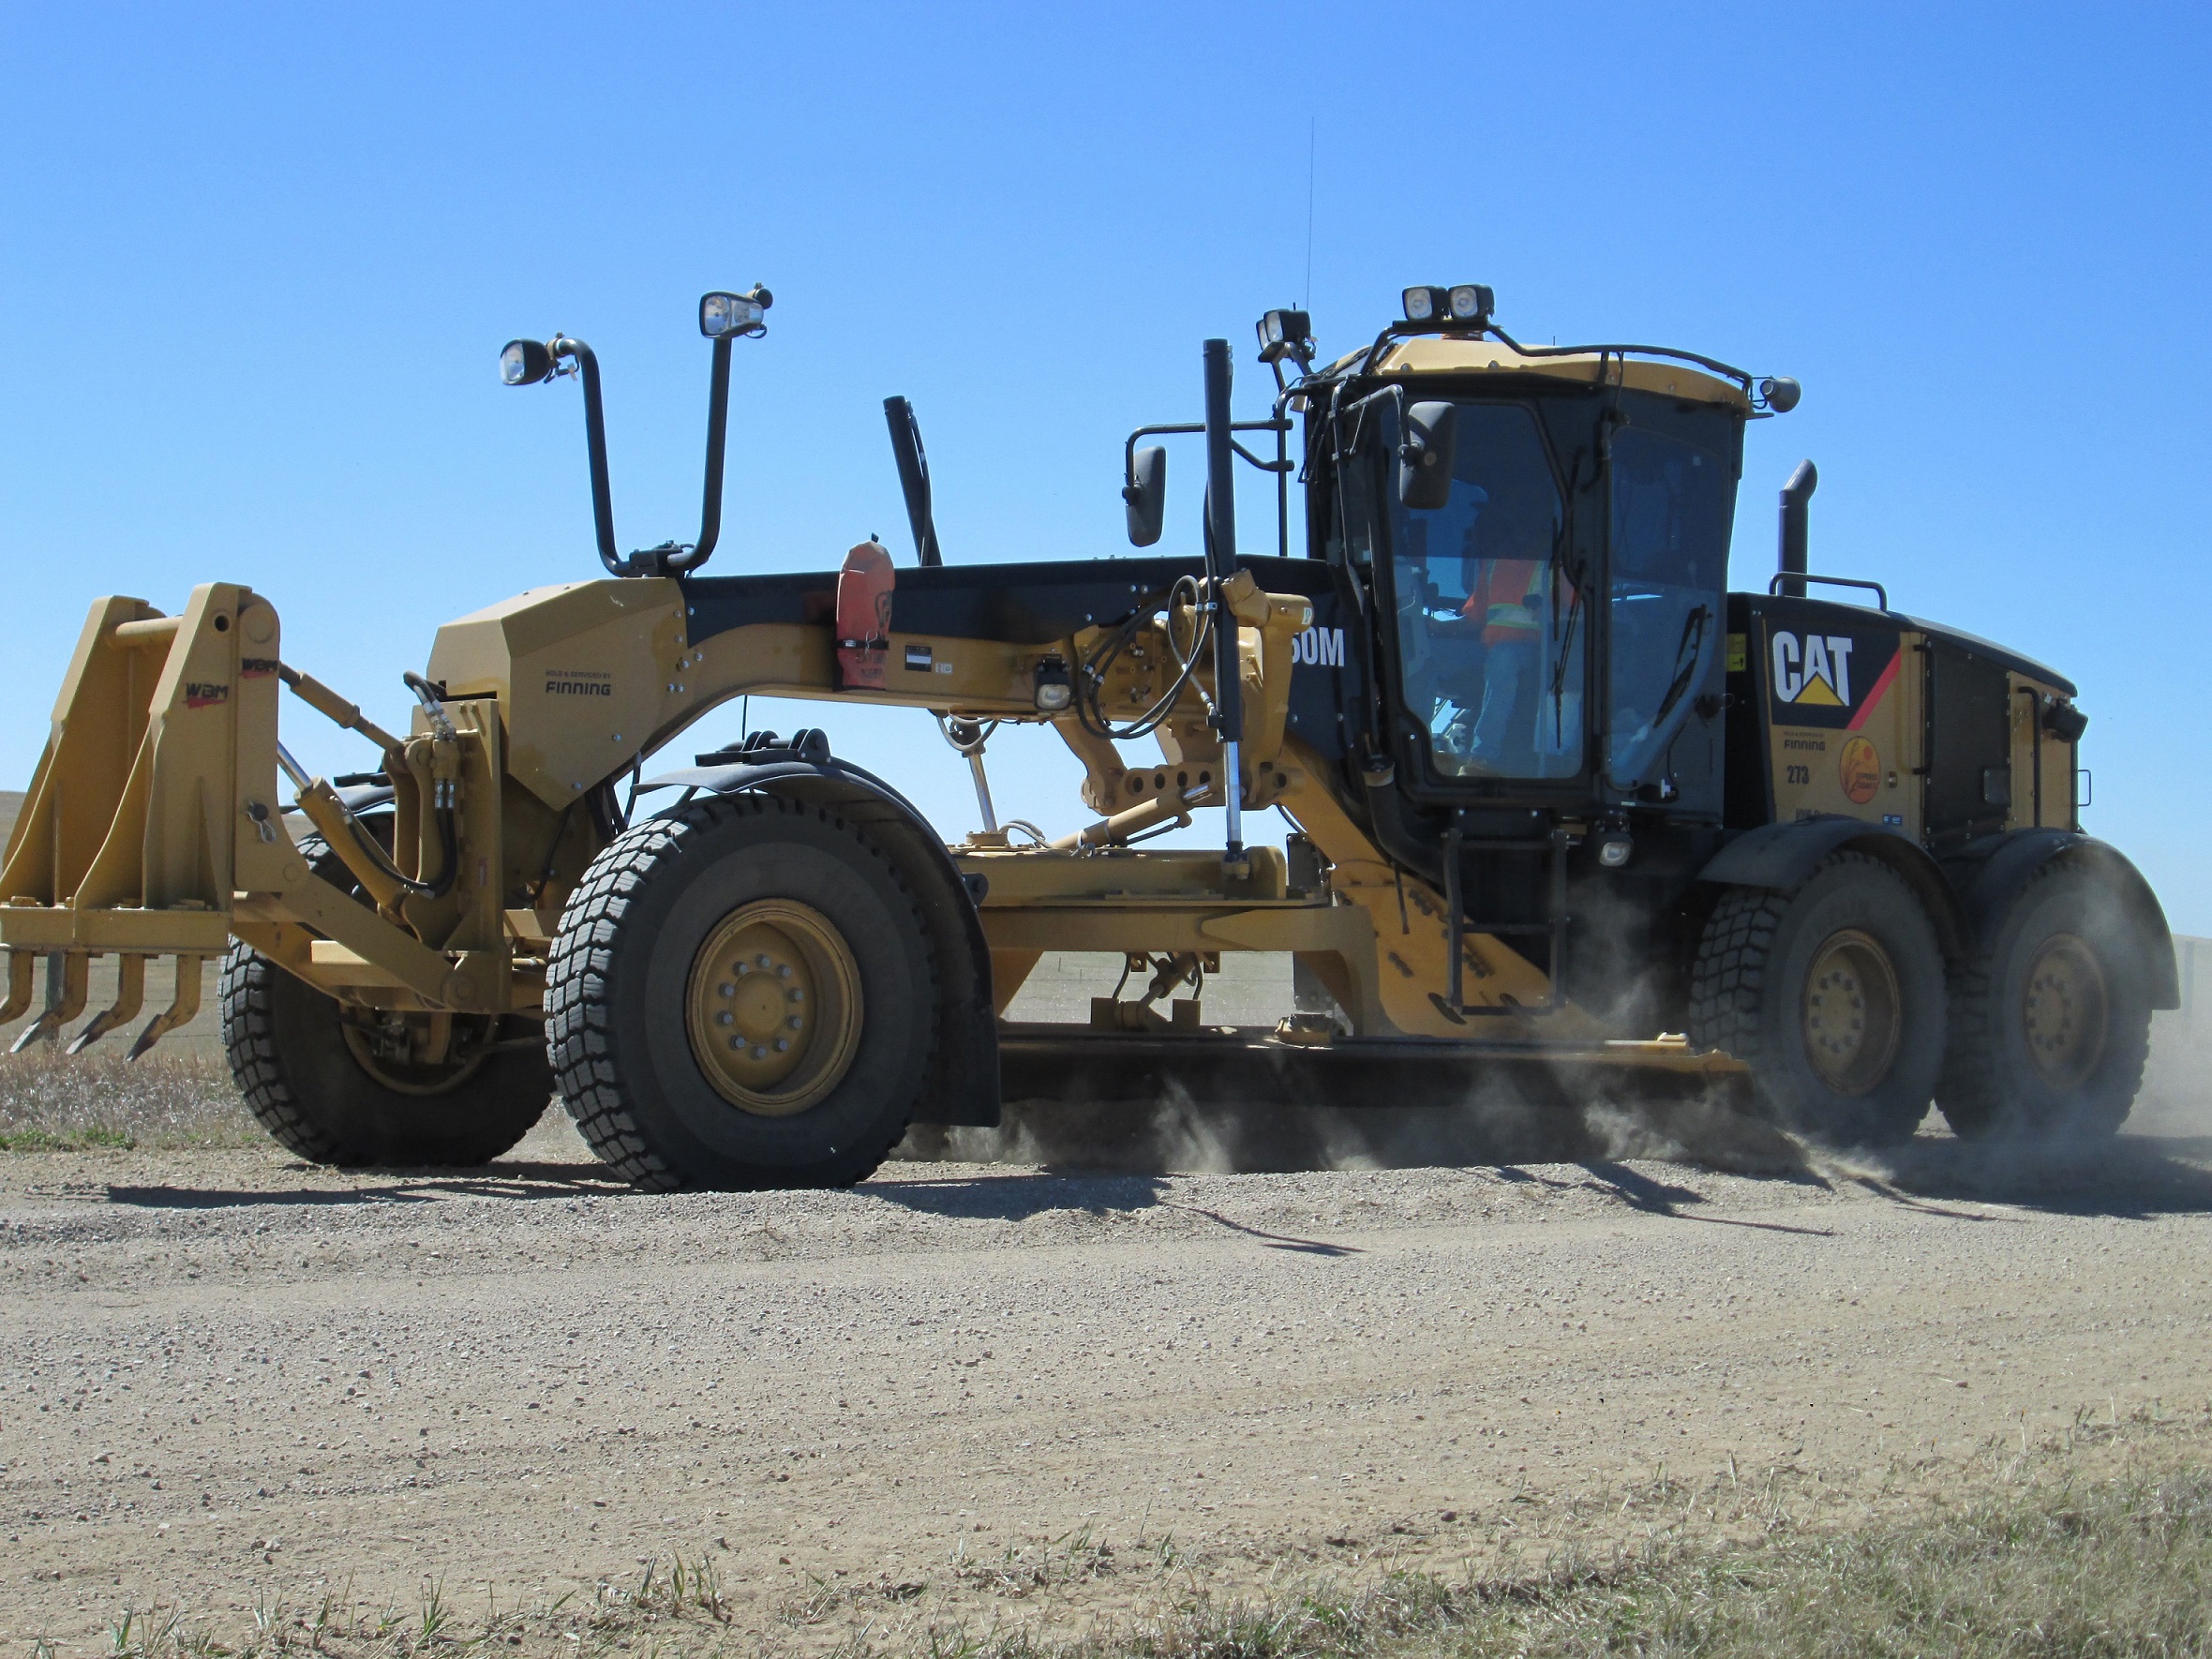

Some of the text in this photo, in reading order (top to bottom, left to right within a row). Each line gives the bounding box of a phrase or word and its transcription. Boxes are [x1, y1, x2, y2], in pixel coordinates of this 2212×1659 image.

[570, 670, 602, 679] SERVICED
[1772, 631, 1853, 706] CAT
[186, 682, 230, 699] WBM
[546, 680, 612, 696] FINNING
[1784, 739, 1826, 751] FINNING
[1786, 765, 1810, 785] 273
